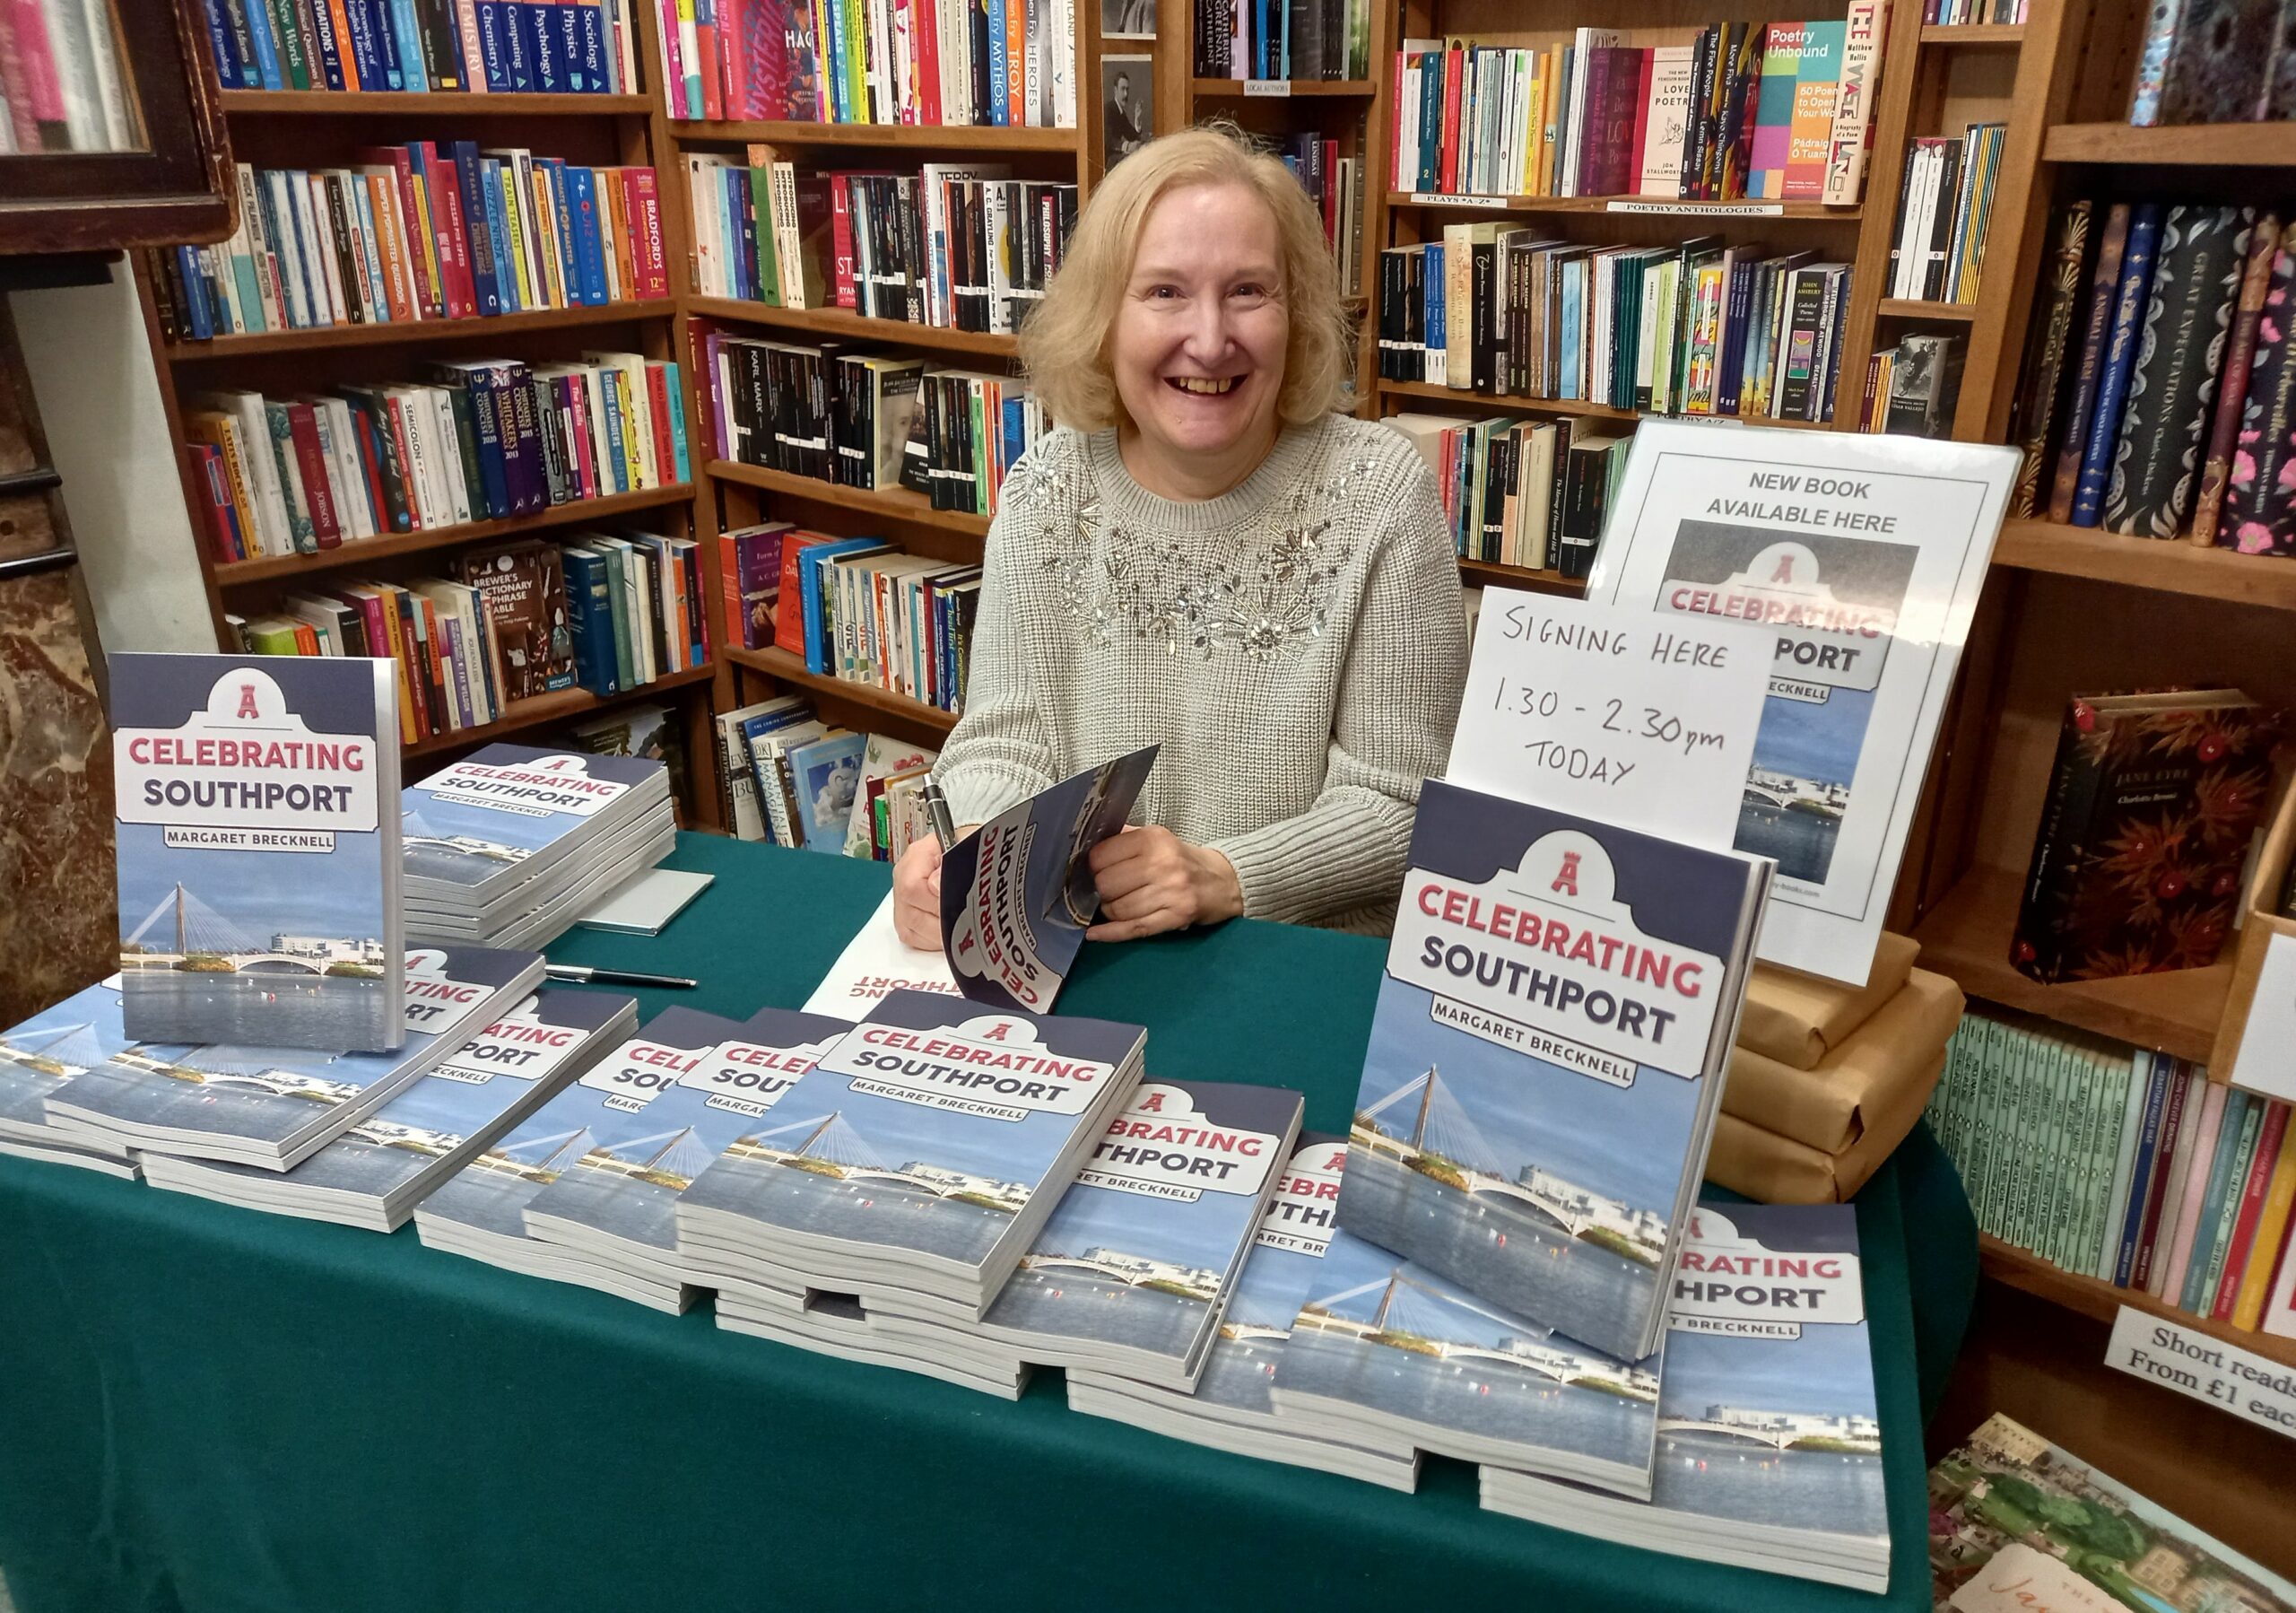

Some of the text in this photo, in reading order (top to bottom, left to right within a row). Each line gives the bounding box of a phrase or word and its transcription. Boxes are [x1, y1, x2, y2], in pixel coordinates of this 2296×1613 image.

[359, 0, 374, 53] Chronology
[482, 4, 499, 69] Chemistry
[507, 5, 523, 69] Computing
[535, 8, 552, 77] Psychology
[562, 8, 578, 60] Physics
[583, 9, 598, 72] Sociology
[833, 4, 844, 53] SPEAKS
[1770, 29, 1815, 45] Poetry
[1851, 4, 1874, 39] THE
[285, 28, 302, 67] Words
[303, 33, 319, 80] Quotations
[354, 34, 369, 80] Literature
[991, 18, 1004, 106] Fry MYTHOS
[1008, 20, 1022, 98] Fry TROY
[1027, 21, 1038, 106] Fry HEROES
[1768, 44, 1829, 59] Unbound
[1847, 43, 1873, 52] Matthew
[1848, 53, 1867, 62] Hollis
[1246, 83, 1289, 94] LOCAL AUTHORS
[1655, 97, 1689, 107] POETR
[1664, 85, 1691, 94] LOVE
[1694, 32, 1718, 172] The Fire People Lemn Sissay
[1714, 44, 1737, 173] More Kayo Chingonyi
[1810, 99, 1835, 109] Open
[1839, 64, 1864, 119] WASTE
[1797, 108, 1818, 118] Your
[378, 178, 388, 213] BUMPER
[383, 214, 396, 262] POPMASTER
[486, 180, 502, 259] PUZZLE NINJA
[505, 177, 520, 249] TRAIN TEASERS
[556, 166, 573, 265] ULTIMATE POP MASTER
[775, 170, 785, 227] INTRODUCING
[781, 170, 790, 228] INTRODUCING
[787, 170, 796, 228] INTRODUCING
[1427, 195, 1460, 204] PLAYS
[1626, 203, 1764, 214] POETRY ANTHOLOGIES
[647, 199, 662, 269] BRADFORD'S
[1042, 201, 1053, 257] PHILOSOPHY
[1796, 288, 1822, 296] ASHBERY
[1811, 294, 1829, 390] MARGARET ATWOOD DEARLY
[2080, 292, 2107, 380] ANIMAL FARM
[2159, 250, 2210, 423] GREAT EXPECTATIONS
[752, 350, 762, 413] KARL MARX
[475, 392, 487, 435] CONCISE
[500, 390, 517, 450] WHITAKER'S
[514, 387, 525, 430] CONCISE
[572, 386, 583, 427] The Skills
[604, 373, 619, 447] GEORGE SAUNDERS
[1656, 414, 1704, 423] POETRY
[405, 404, 420, 459] SEMICOLON
[225, 429, 243, 495] LATIN ROCKS
[1552, 489, 1561, 509] Marriage
[1749, 472, 1873, 500] NEW BOOK
[314, 490, 330, 528] JOBSON
[1551, 515, 1559, 531] Heaven
[1706, 498, 1898, 534] AVAILABLE HERE
[473, 572, 519, 589] BREWER'S
[480, 579, 534, 598] ICTIONARY
[491, 590, 527, 604] PHRASE
[493, 603, 515, 615] ABLE
[946, 610, 957, 650] head first
[1670, 588, 1882, 640] CELEBRATING
[1502, 606, 1628, 656] SIGNING
[1650, 632, 1729, 669] HERE
[468, 638, 480, 684] JOURNALISM
[956, 647, 968, 695] Complicated
[460, 684, 471, 712] WELDON
[1768, 681, 1828, 700] ECKNELL
[1494, 676, 1559, 717] 1.30
[1602, 698, 1725, 756] 2.30pm
[129, 737, 364, 772] CELEBRATING
[721, 739, 733, 796] EVERYBODY'S
[753, 745, 770, 757] DK
[1525, 740, 1636, 786] TODAY
[144, 779, 352, 813] SOUTHPORT
[439, 778, 592, 808] SOUTHPORT
[454, 765, 618, 796] CELEBRATING
[2115, 768, 2190, 787] JANE EYRE
[435, 793, 552, 817] MARGARET BRECKNELL
[167, 831, 334, 848] MARGARET BRECKNELL
[996, 824, 1039, 981] SOUTHPORT
[1418, 884, 1704, 998] CELEBRATING
[854, 975, 961, 993] THPORT
[1420, 935, 1676, 1045] SOUTHPORT
[863, 1029, 1098, 1082] CELEBRATING
[1434, 1003, 1631, 1082] MARGARET BRECKNELL
[434, 1067, 487, 1083] ECKNELL
[852, 1051, 1071, 1102] SOUTHPORT
[853, 1080, 1024, 1121] MARGARET BRECKNELL
[1107, 1119, 1265, 1157] BRATING
[2164, 1121, 2177, 1154] DRINKING
[1093, 1142, 1240, 1181] THPORT
[1107, 1176, 1198, 1200] BRECKNELL
[1681, 1251, 1842, 1279] RATING
[1674, 1279, 1826, 1310] HPORT
[1687, 1320, 1798, 1337] BRECKNELL
[2151, 1326, 2296, 1398] Short reads
[2126, 1347, 2296, 1428] From £1 eac
